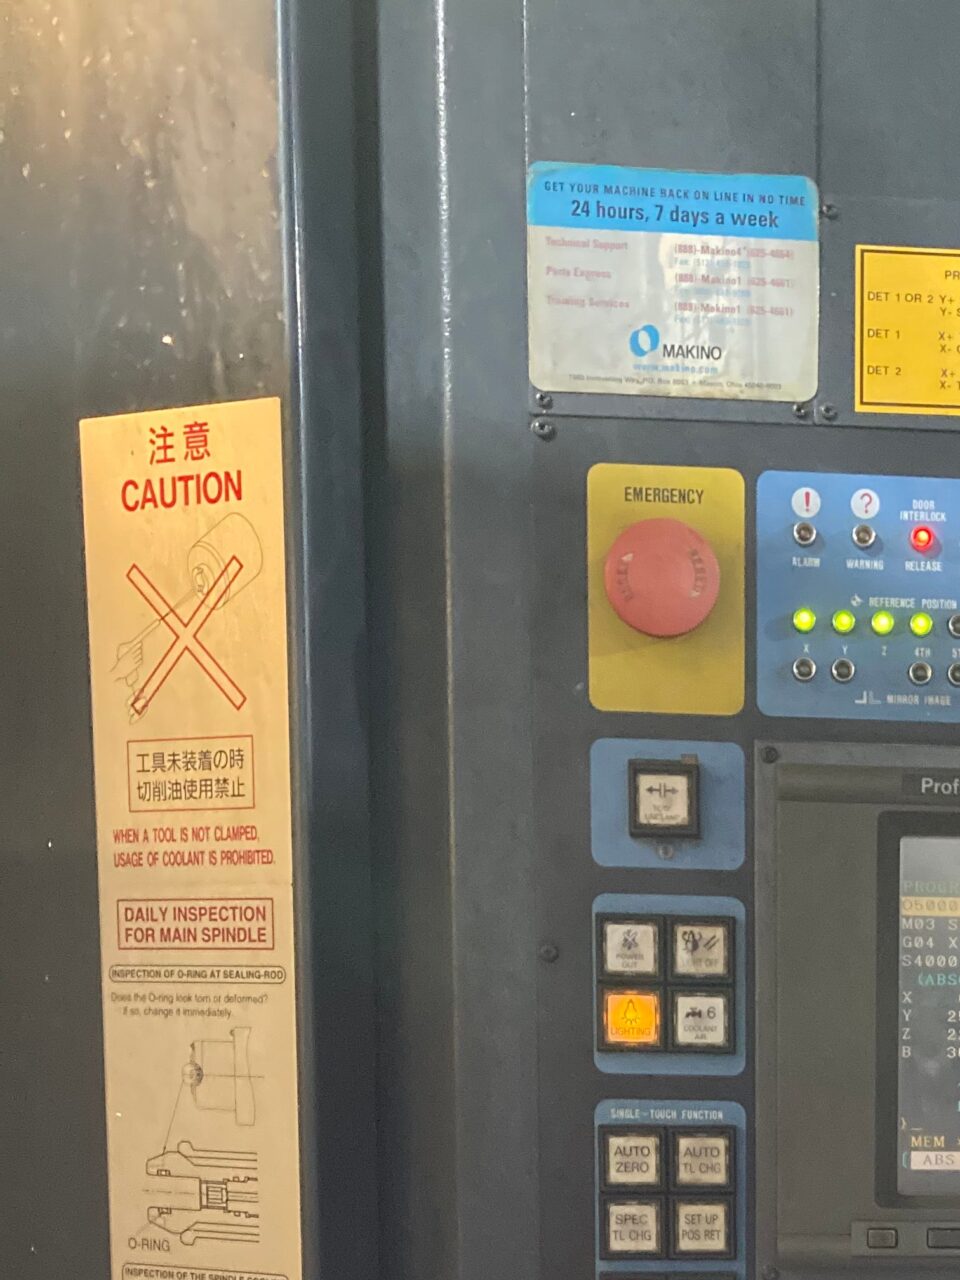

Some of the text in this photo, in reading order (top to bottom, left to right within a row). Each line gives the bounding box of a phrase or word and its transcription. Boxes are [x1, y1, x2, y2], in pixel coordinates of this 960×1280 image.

[544, 181, 805, 206] GET YOUR MACHINE BACK ON LINE IN NO TIME
[571, 200, 779, 227] 24 hours, 7 days a week
[867, 291, 889, 302] DET
[895, 292, 901, 302] 1
[904, 293, 922, 303] OR
[927, 294, 934, 304] 2
[939, 294, 954, 304] Y+
[939, 307, 952, 317] Y-
[867, 328, 901, 339] DET 1
[938, 331, 953, 341] X+
[662, 344, 722, 361] MAKINO
[939, 344, 952, 354] X-
[867, 365, 902, 376] DET 2
[940, 368, 956, 378] X+
[939, 381, 952, 391] X-
[149, 421, 211, 465] 注意
[121, 470, 243, 512] CAUTION
[624, 486, 704, 505] EMERGENCY
[846, 559, 884, 571] WARNING
[904, 560, 943, 573] RELEASE
[136, 748, 244, 773] 工具未装着の時
[137, 777, 246, 802] 切削油使用禁止
[113, 825, 260, 843] WHEN A TOOL IS NOT CLAMPED,
[114, 852, 143, 868] USAGE
[147, 852, 159, 866] OF
[162, 850, 205, 866] COOLANT
[208, 851, 217, 865] IS
[124, 905, 266, 922] DAILY INSPECTION
[902, 918, 936, 930] M03
[125, 927, 267, 943] FOR MAIN SPINDLE
[902, 936, 935, 949] G04
[902, 955, 958, 967] S4000
[112, 968, 162, 979] INSPECTION
[163, 969, 175, 979] OF
[177, 969, 207, 979] O-RING
[209, 970, 220, 979] AT
[910, 1135, 945, 1148] MEM
[614, 1145, 651, 1158] AUTO
[683, 1146, 720, 1158] AUTO
[615, 1161, 649, 1174] ZERO
[682, 1161, 721, 1174] TL CHG
[615, 1213, 648, 1226] SPEC
[684, 1214, 719, 1226] SET UP
[613, 1229, 652, 1241] TL CHG
[681, 1229, 721, 1241] POS RET
[127, 1236, 171, 1252] O-RING
